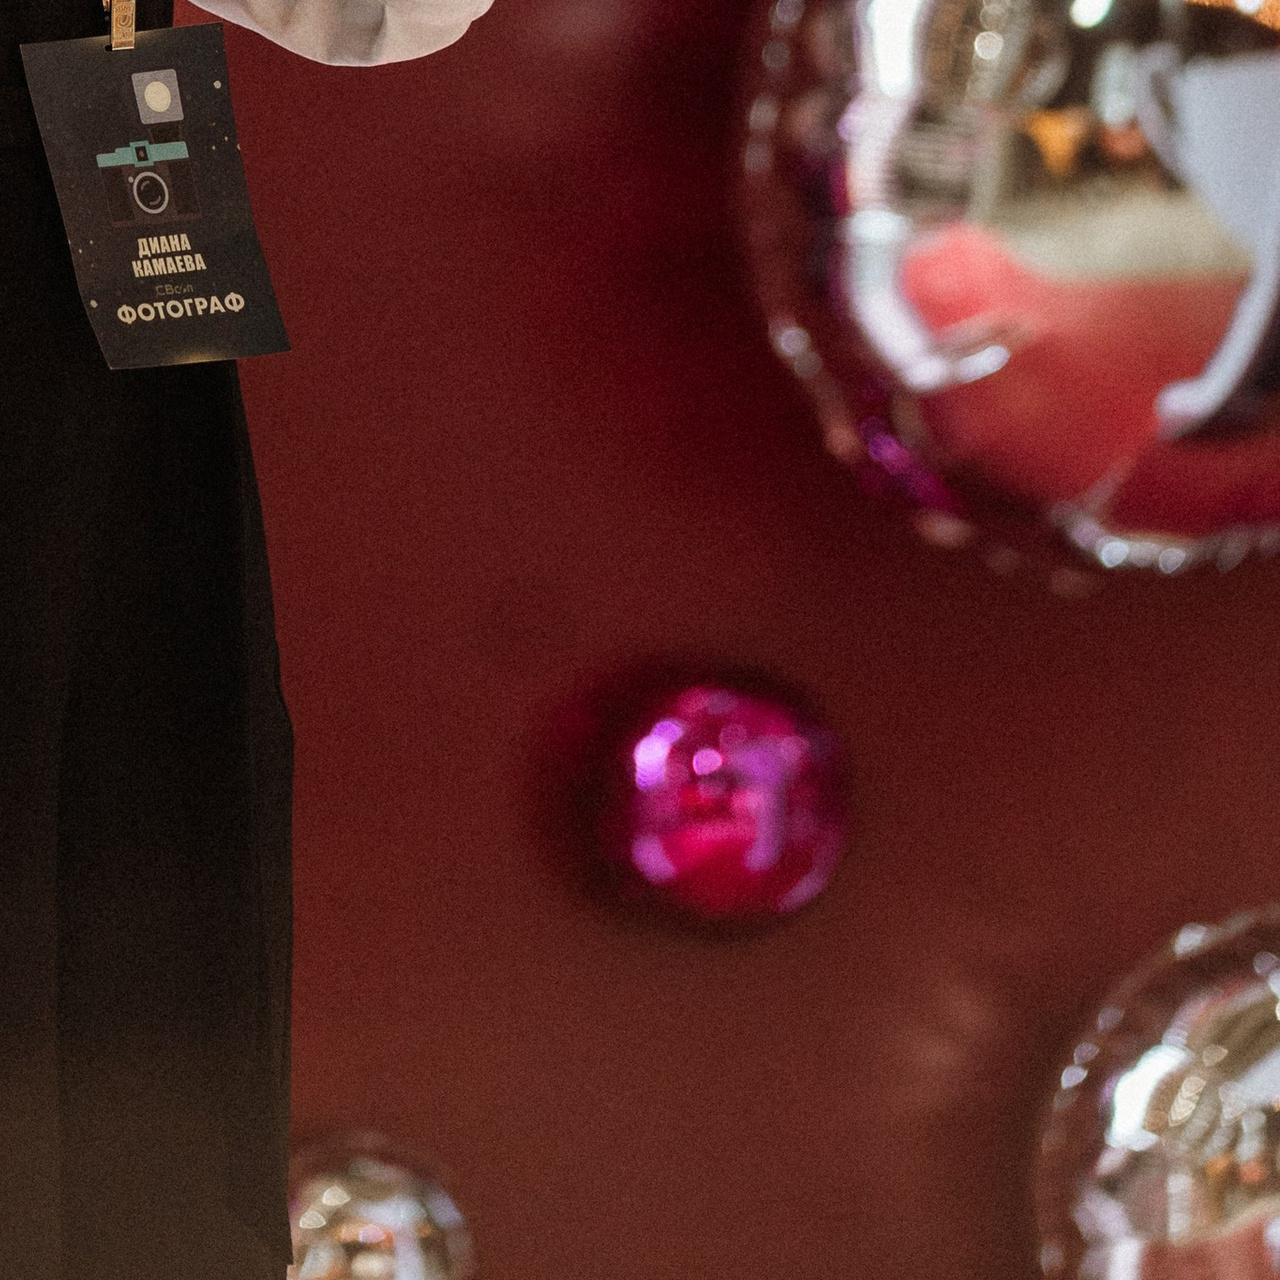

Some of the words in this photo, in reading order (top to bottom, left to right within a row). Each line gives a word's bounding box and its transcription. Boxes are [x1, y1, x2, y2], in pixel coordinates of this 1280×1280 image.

[137, 233, 191, 258] ДИАНА
[131, 253, 207, 278] КАМАЕВА
[117, 292, 245, 325] ФОТОГРАФ
